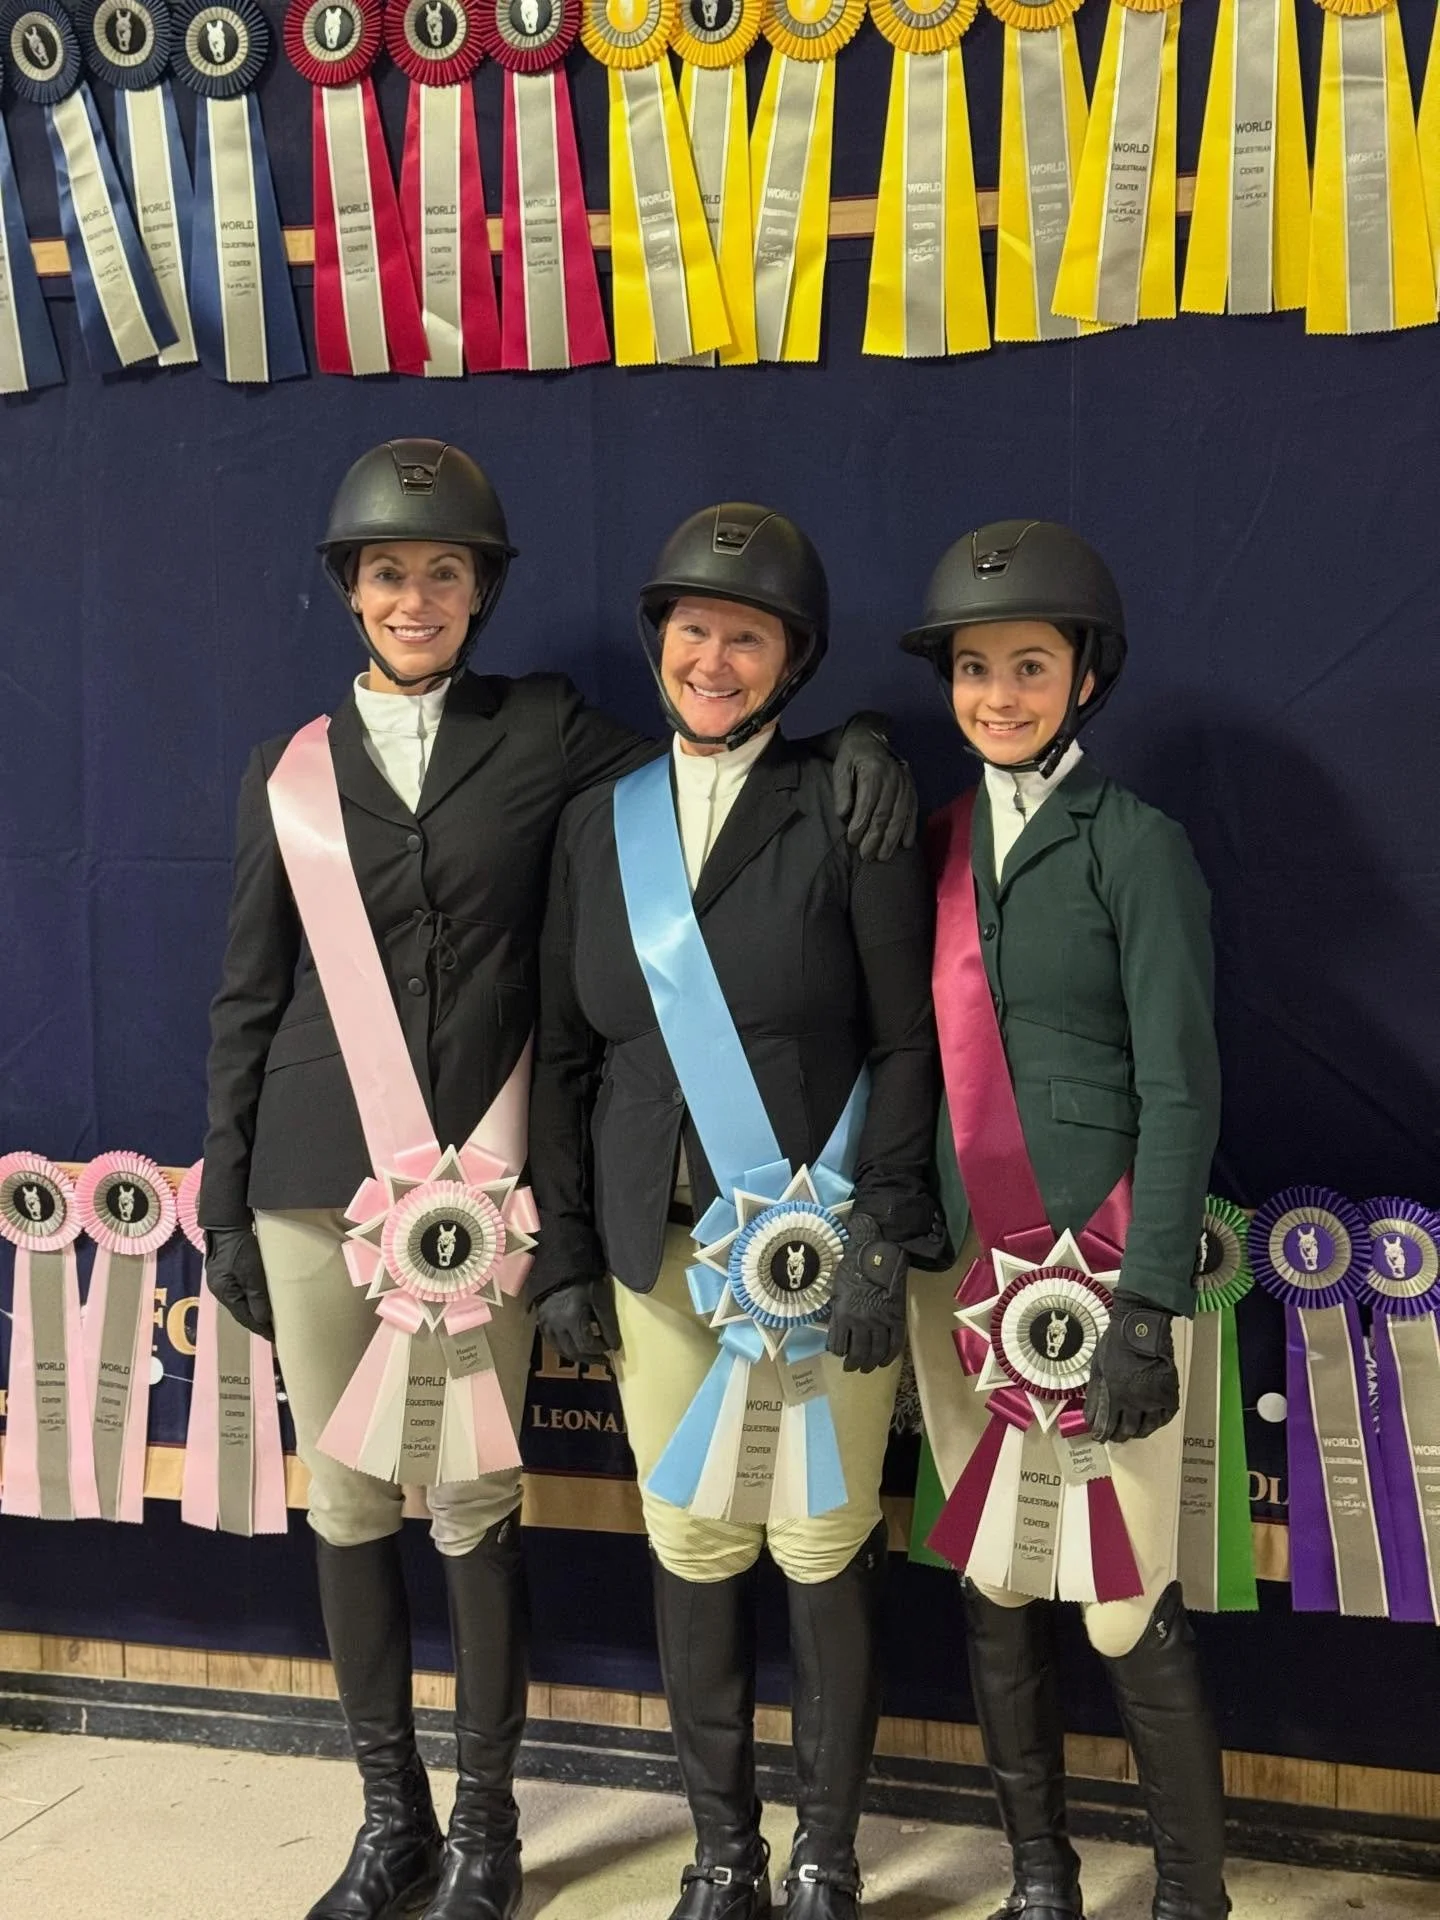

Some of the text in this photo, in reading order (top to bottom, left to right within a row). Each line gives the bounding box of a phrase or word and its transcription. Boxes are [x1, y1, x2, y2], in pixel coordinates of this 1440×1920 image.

[1235, 120, 1273, 134] WORLD
[1114, 142, 1150, 154] WORLD
[1348, 151, 1385, 164] WORLD
[1030, 162, 1066, 175] WORLD
[1112, 163, 1147, 172] EQUESTRIAN
[1240, 166, 1265, 175] CENTER
[907, 182, 941, 193] WORLD
[1115, 183, 1139, 191] CENTER
[640, 190, 671, 207] WORLD
[767, 187, 800, 201] WORLD
[142, 201, 171, 214] WORLD
[338, 203, 369, 215] WORLD
[524, 199, 556, 209] WORLD
[82, 205, 109, 225] WORLD
[425, 205, 457, 215] WORLD
[220, 220, 254, 230] WORLD
[37, 1362, 65, 1371] WORLD
[101, 1361, 130, 1375] WORLD
[219, 1375, 250, 1385] WORLD
[408, 1376, 446, 1386] WORLD
[746, 1400, 783, 1411] WORLD
[531, 1404, 628, 1434] LEONA
[743, 1424, 780, 1432] EQUESTRIAN
[1323, 1437, 1360, 1448] WORLD
[746, 1446, 771, 1454] CENTER
[1020, 1470, 1061, 1486] WORLD
[1018, 1495, 1059, 1509] EQUESTRIAN
[1023, 1517, 1050, 1529] CENTER
[1030, 1545, 1054, 1556] PLACE
